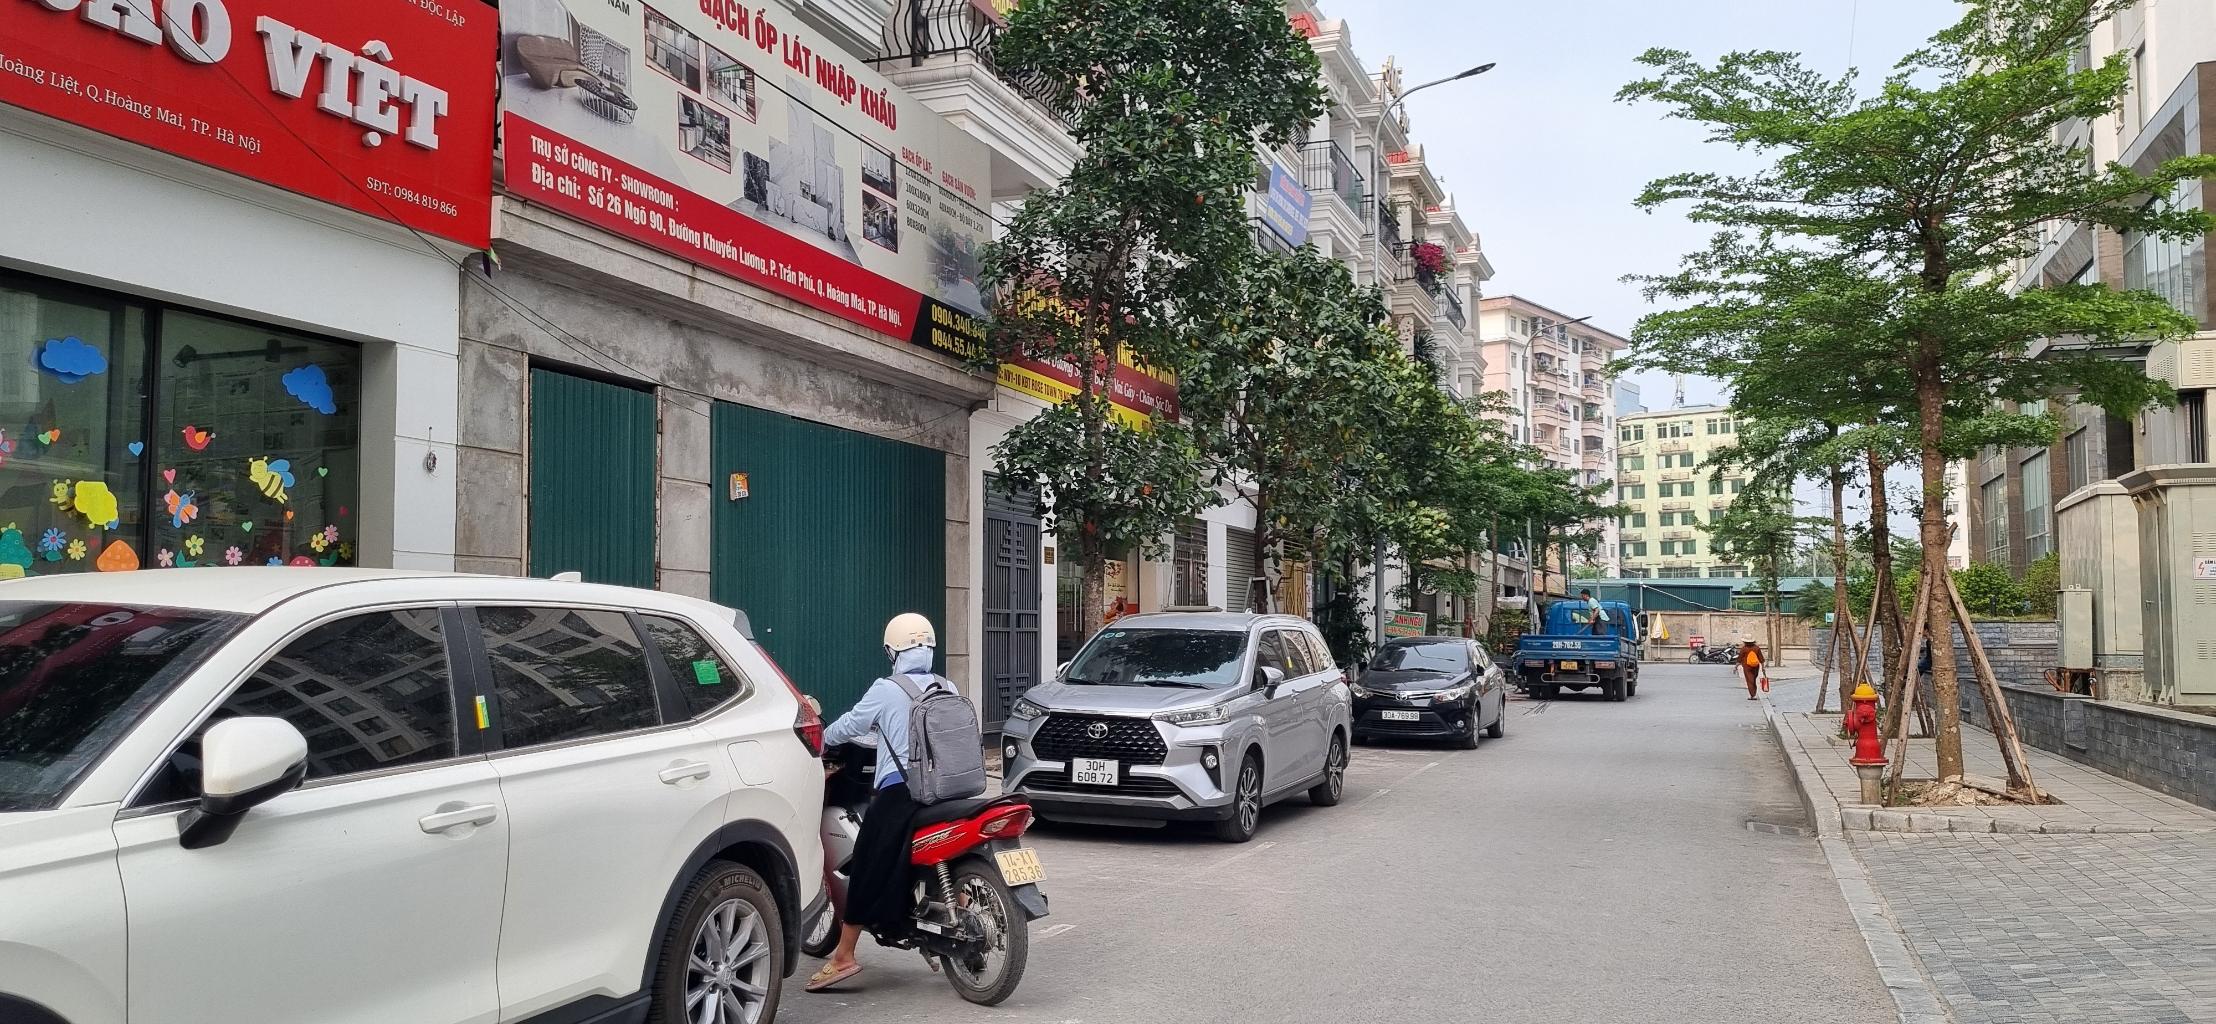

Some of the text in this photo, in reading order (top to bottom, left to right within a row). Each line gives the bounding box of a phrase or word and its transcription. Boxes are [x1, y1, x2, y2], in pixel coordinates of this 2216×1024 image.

[446, 9, 465, 27] LẬP
[256, 15, 448, 150] VIỆT
[755, 8, 778, 54] ỐP
[782, 33, 812, 77] LÁT
[815, 54, 857, 106] NHẬP
[860, 83, 897, 131] KHẨU
[50, 71, 83, 97] Liệt,
[87, 84, 103, 103] Q.
[105, 88, 152, 119] Hoàng
[157, 107, 186, 131] Mai,
[191, 118, 212, 137] TP.
[216, 127, 235, 145] Hà
[238, 134, 261, 155] Nội
[366, 176, 457, 217] SĐT: 0984 819 866
[531, 135, 551, 162] TRỤ
[554, 144, 569, 166] SỞ
[571, 152, 599, 179] CÔNG
[600, 164, 613, 184] TY
[621, 173, 674, 211] SHOWROOM
[531, 162, 554, 191] Địa
[557, 176, 581, 200] chỉ:
[588, 185, 604, 209] Số
[606, 192, 622, 216] 26
[624, 199, 647, 225] Ngõ
[649, 210, 667, 236] 90,
[668, 217, 700, 248] Đường
[703, 231, 737, 261] Khuyến
[740, 246, 768, 276] Lương,
[770, 259, 778, 277] P.
[798, 271, 816, 294] Phú,
[817, 279, 825, 297] Q.
[827, 282, 850, 308] Hoàng
[850, 292, 866, 314] Mai,
[867, 299, 878, 317] TP.
[878, 303, 888, 320] Hà
[1077, 771, 1113, 784] 608.72
[1085, 760, 1106, 772] 30H
[1002, 850, 1035, 868] 14-X1
